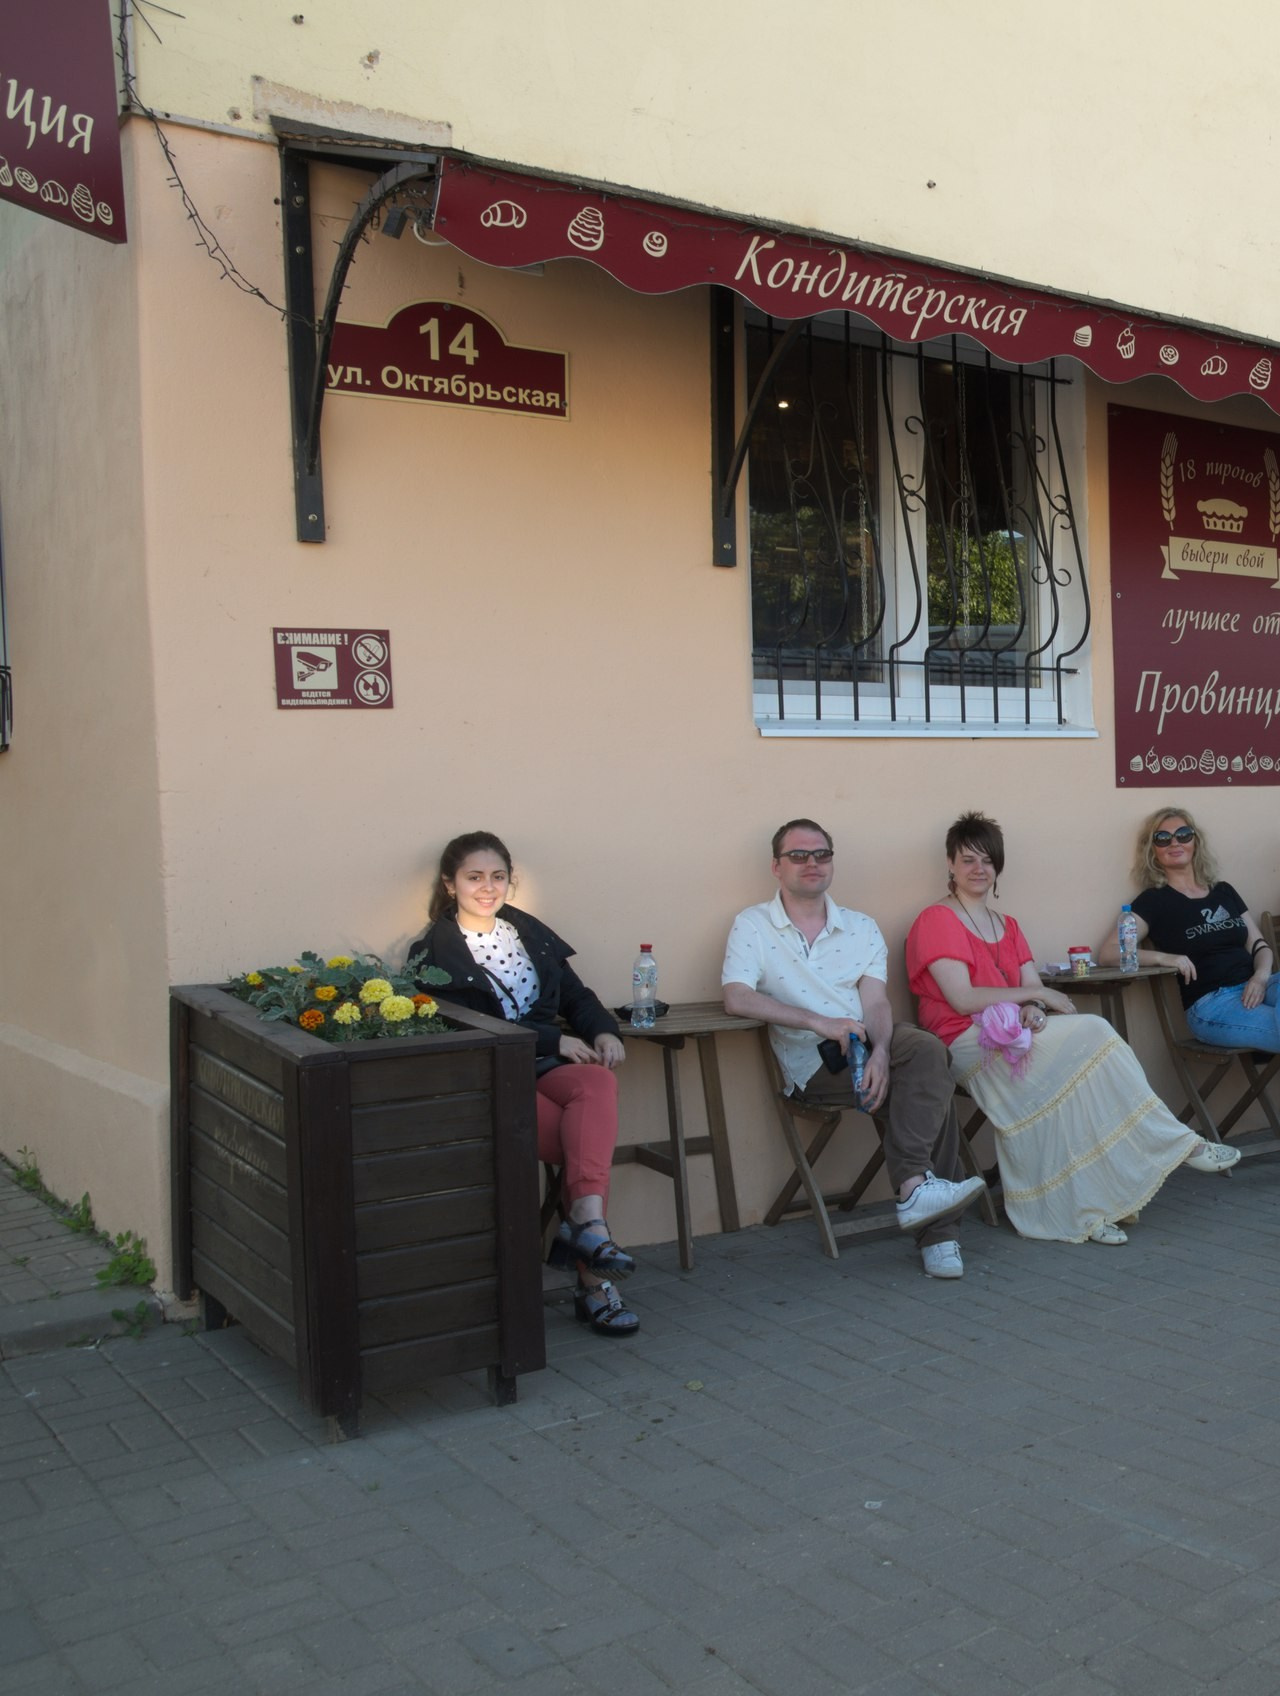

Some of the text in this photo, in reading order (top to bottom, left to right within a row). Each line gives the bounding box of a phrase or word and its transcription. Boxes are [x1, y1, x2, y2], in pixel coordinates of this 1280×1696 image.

[734, 235, 1028, 340] Кондитерская
[419, 317, 480, 366] 14
[327, 364, 561, 409] ул. Октябрьская
[1180, 459, 1264, 488] 18 пирогов
[1181, 540, 1265, 573] выбери свой
[1162, 608, 1241, 645] лучшее
